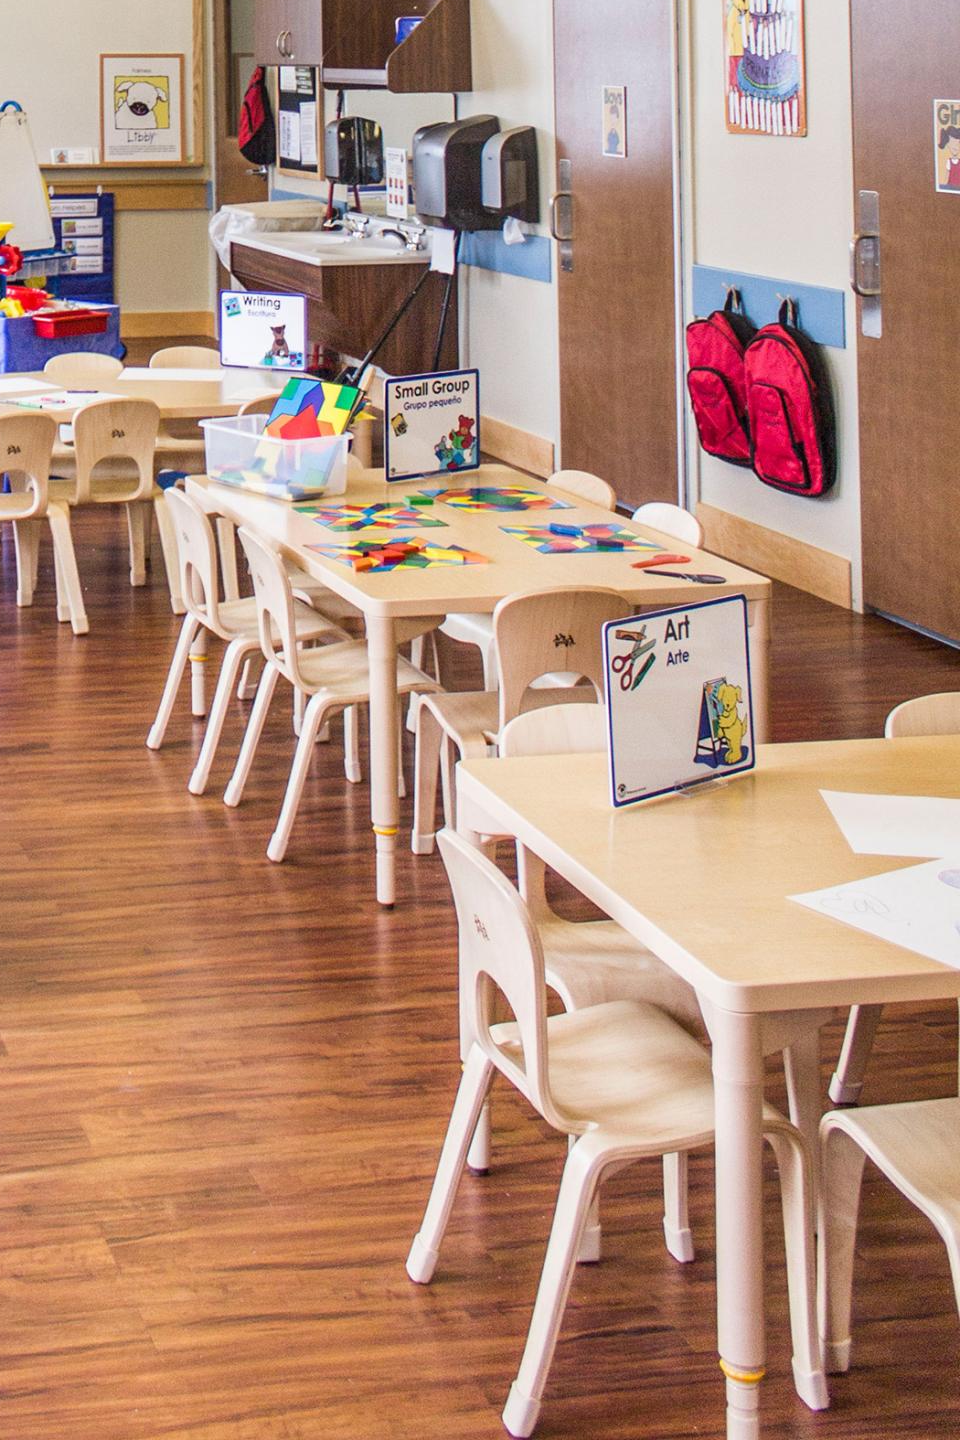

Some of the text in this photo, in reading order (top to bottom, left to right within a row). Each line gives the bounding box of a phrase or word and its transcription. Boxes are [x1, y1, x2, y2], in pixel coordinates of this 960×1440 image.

[243, 295, 281, 311] Writing
[395, 380, 470, 399] Small Group
[403, 395, 462, 411] Grupo pequeño
[664, 614, 690, 643] Art
[666, 649, 690, 667] Arte
